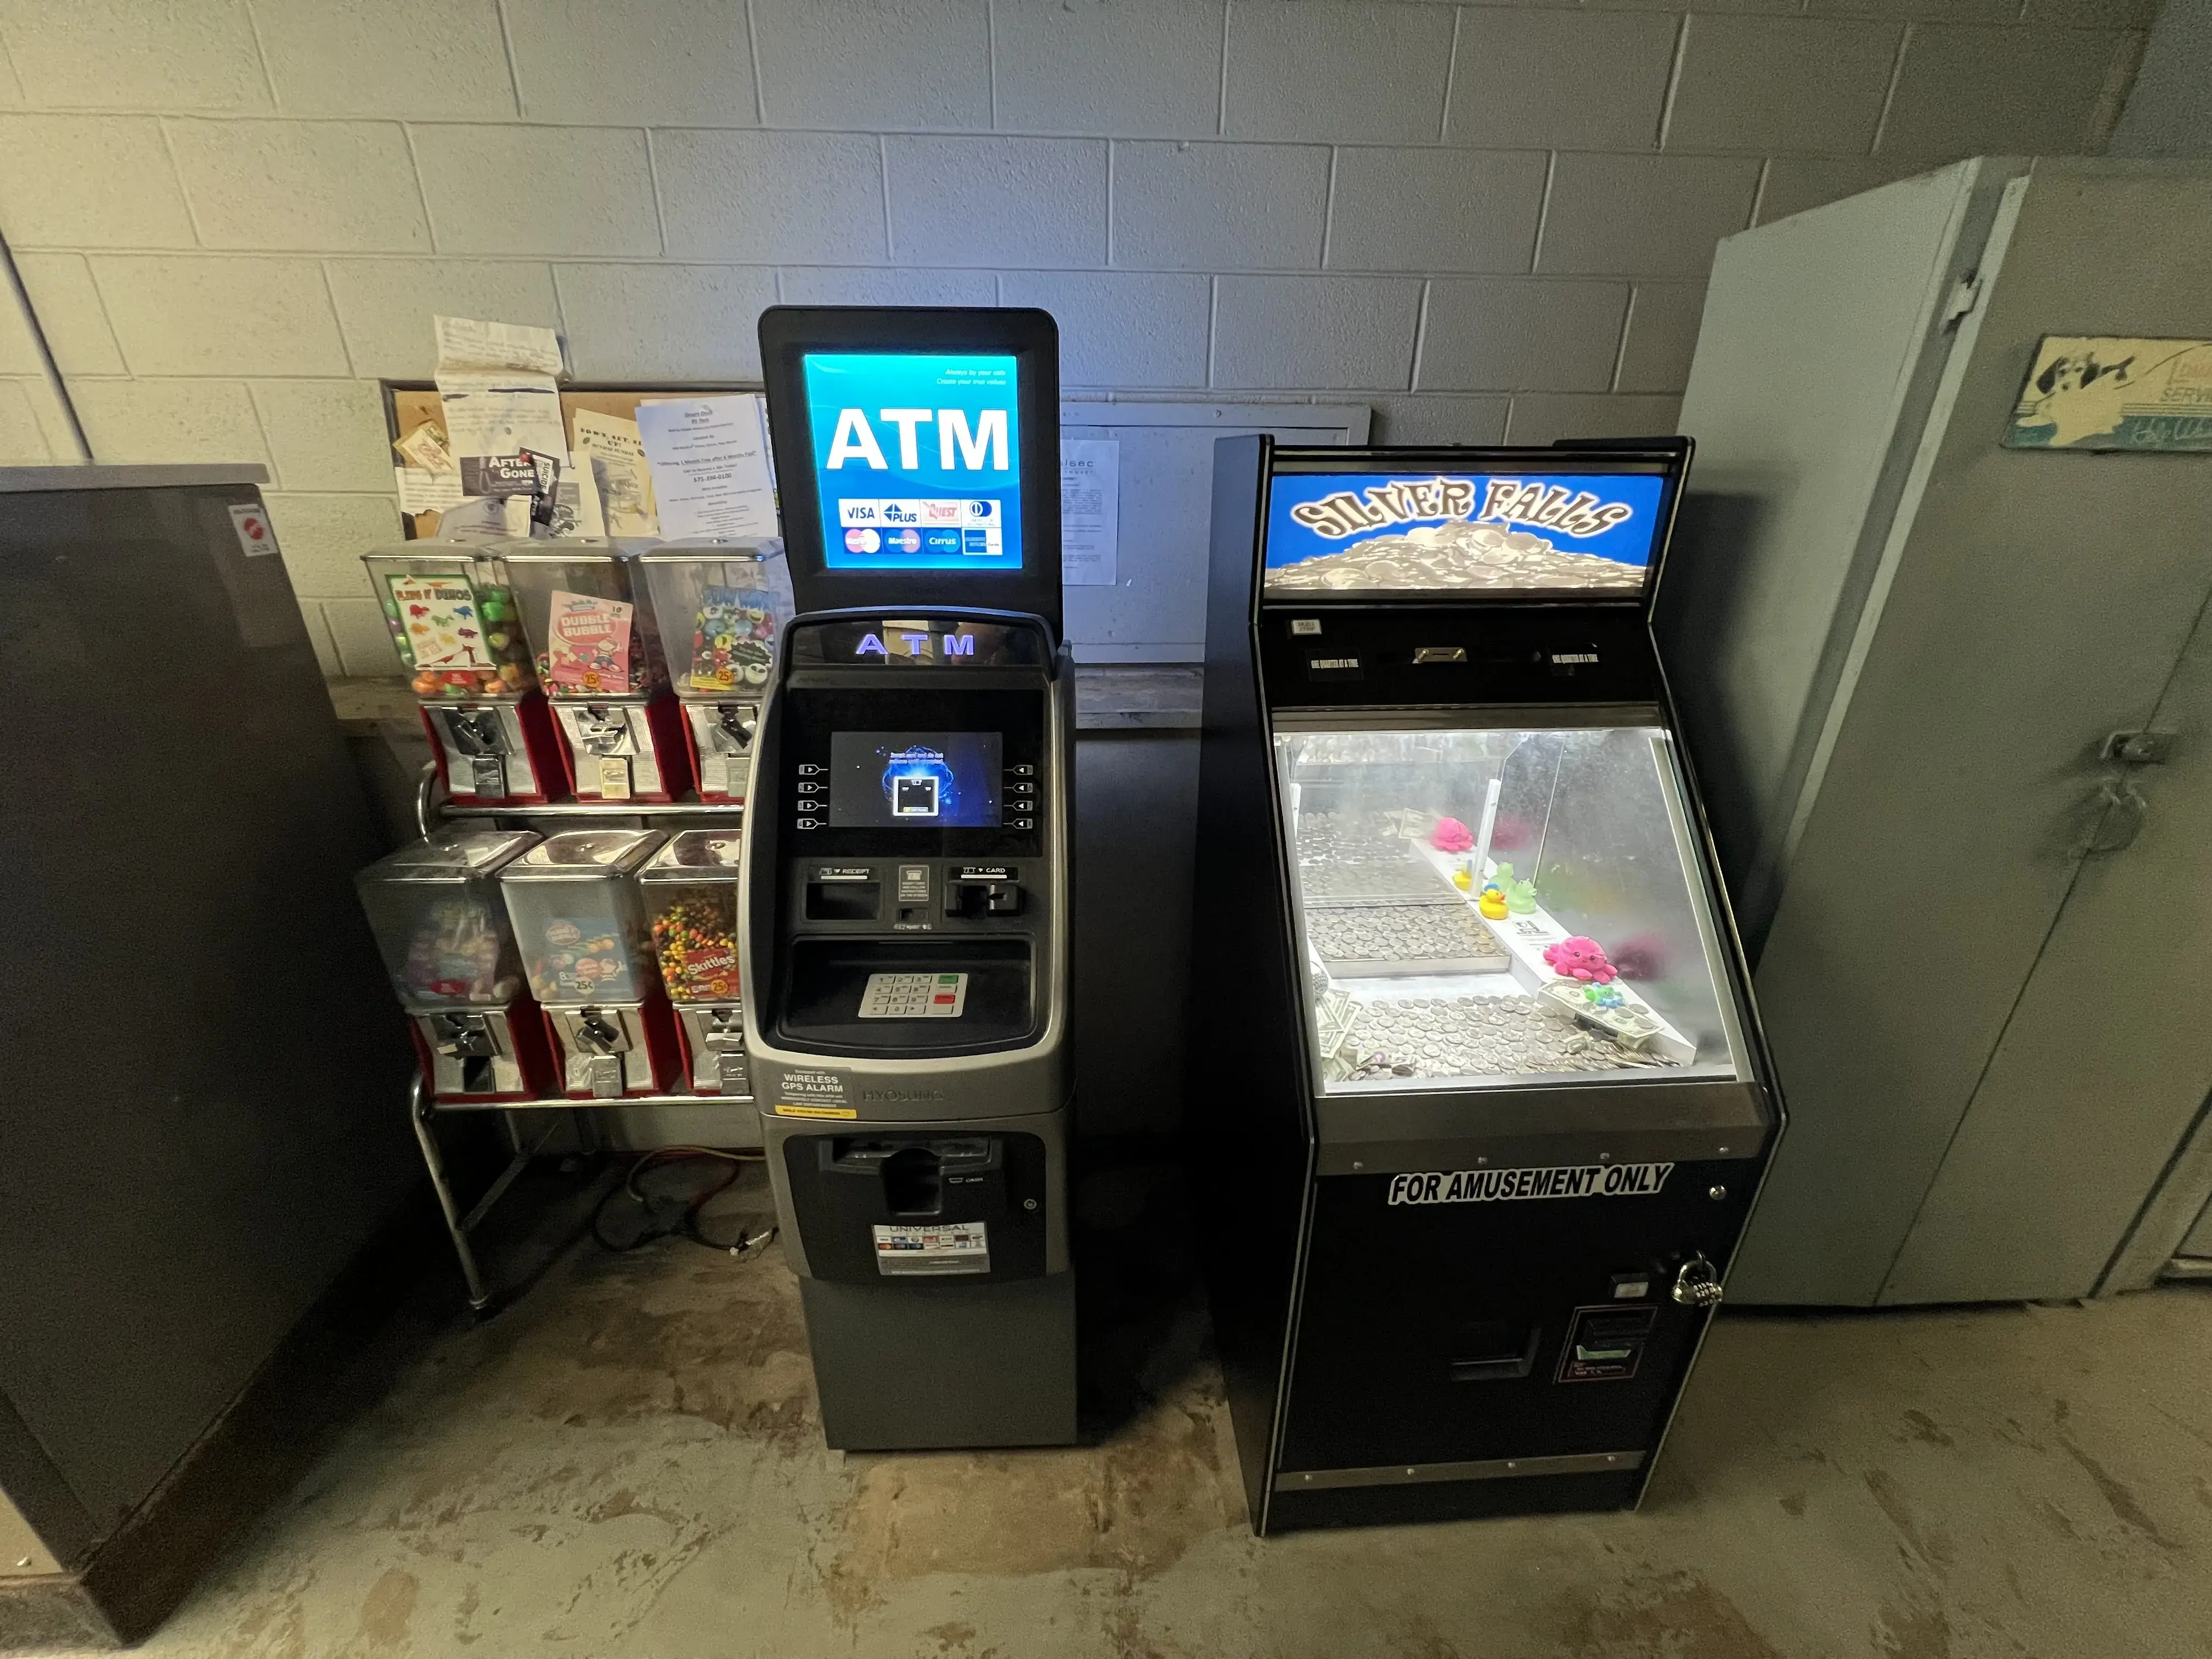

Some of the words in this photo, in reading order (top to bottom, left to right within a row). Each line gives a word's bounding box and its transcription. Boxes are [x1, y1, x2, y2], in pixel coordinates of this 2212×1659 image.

[826, 408, 1009, 471] ATM
[500, 467, 535, 479] GONE
[847, 507, 875, 519] VISA
[893, 513, 917, 522] PLUS
[928, 503, 957, 520] QUEST
[1294, 479, 1473, 537] SILVER
[1481, 479, 1630, 535] FALLS
[929, 537, 956, 545] Cirrus
[561, 613, 610, 627] DUBBLE
[563, 624, 612, 637] BUBBLE
[687, 956, 736, 975] Skittles
[575, 980, 594, 990] 25¢
[783, 1074, 838, 1084] WIRELESS
[781, 1082, 804, 1091] GPS
[806, 1084, 844, 1092] ALARM
[1392, 1174, 1442, 1202] FOR
[1446, 1166, 1599, 1200] AMUSEMENT
[1604, 1165, 1671, 1193] ONLY
